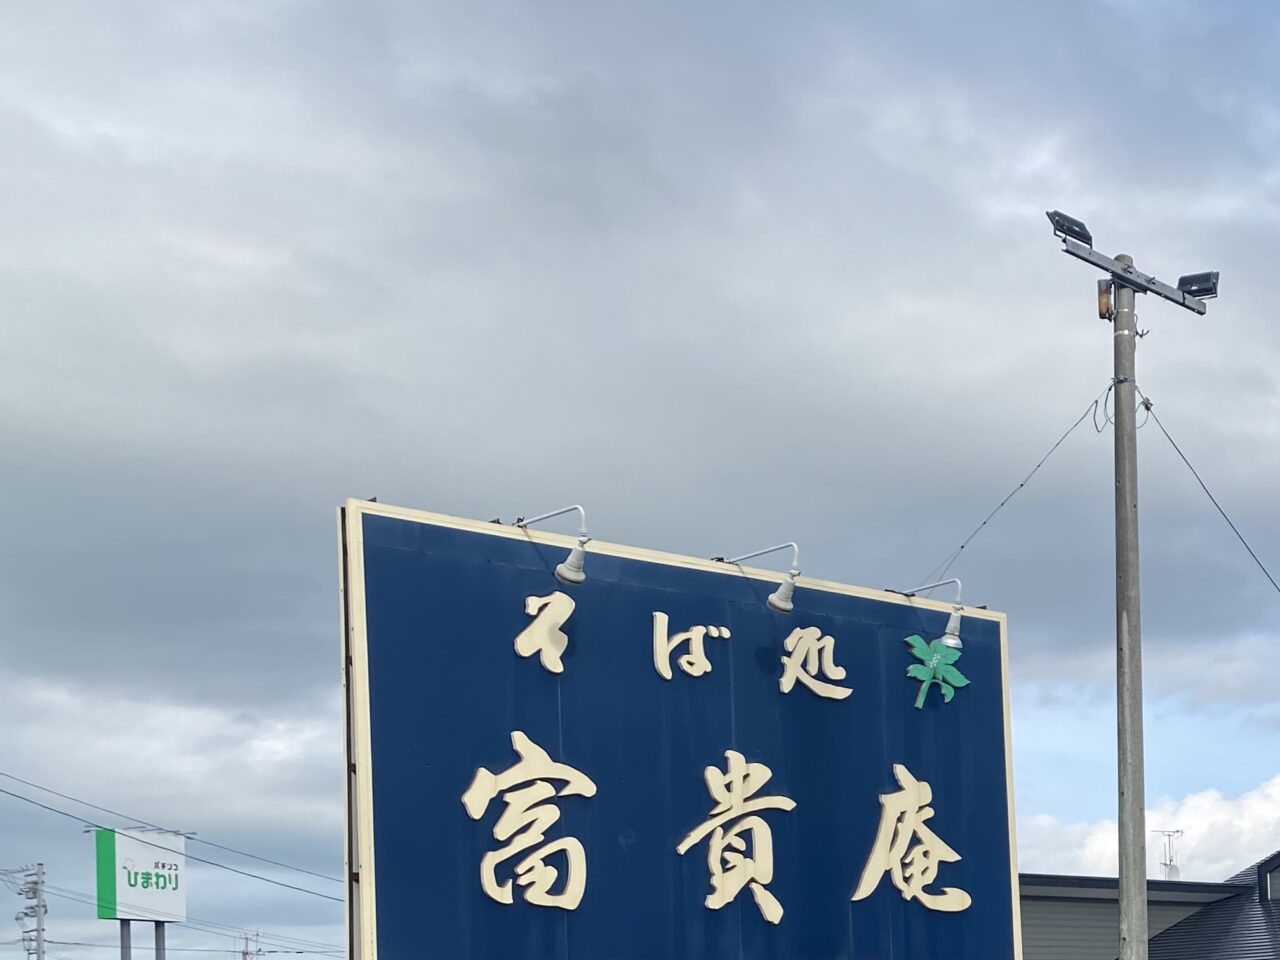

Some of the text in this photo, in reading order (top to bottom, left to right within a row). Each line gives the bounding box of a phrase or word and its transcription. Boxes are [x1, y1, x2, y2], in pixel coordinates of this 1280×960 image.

[514, 590, 853, 700] そば処
[461, 730, 972, 925] 富貴庵
[123, 865, 179, 891] ひまわり
[153, 861, 179, 871] パチンコ
